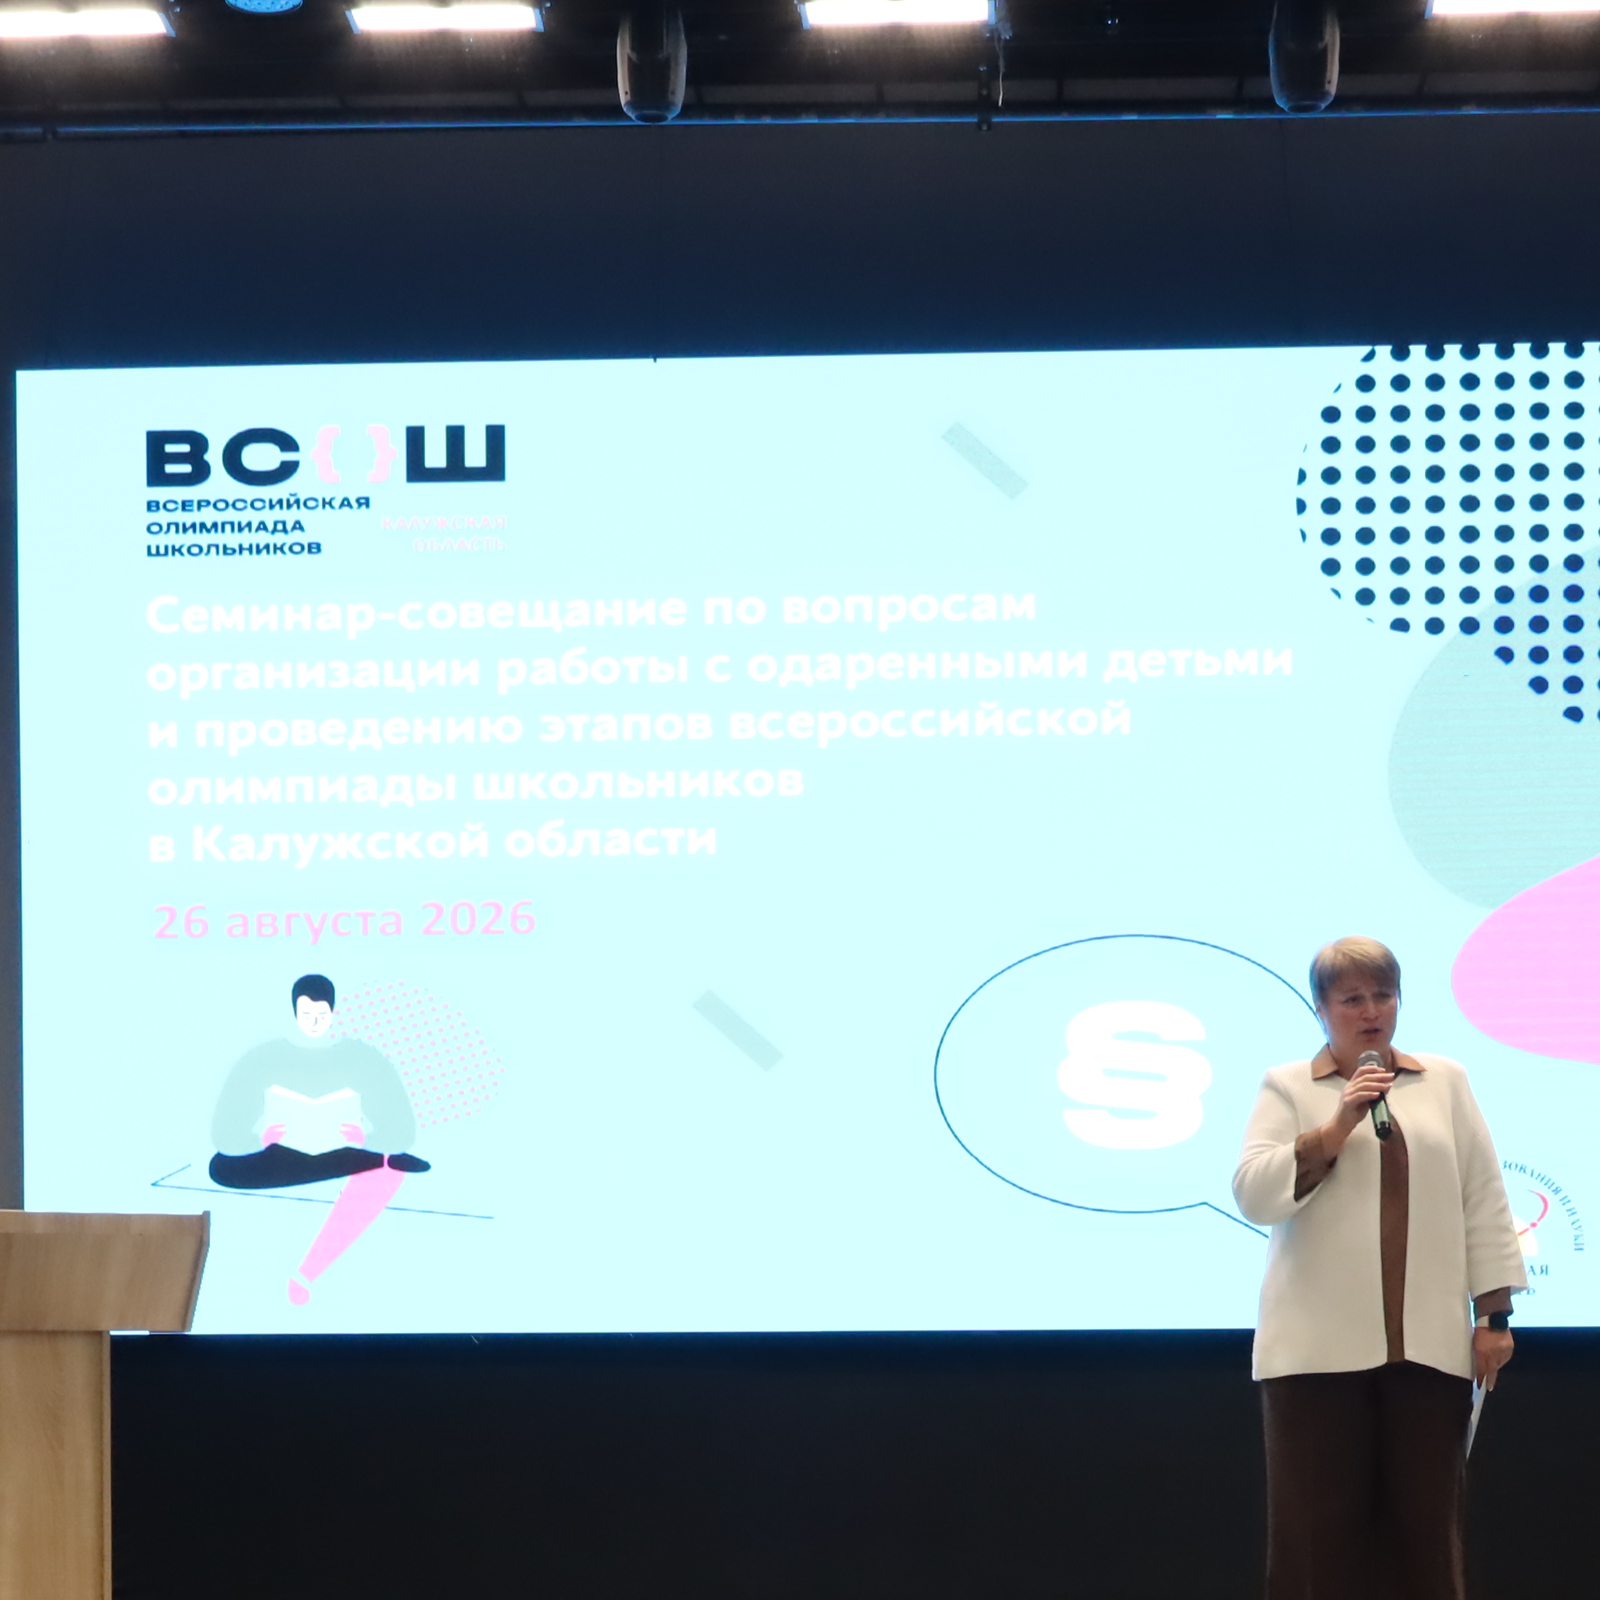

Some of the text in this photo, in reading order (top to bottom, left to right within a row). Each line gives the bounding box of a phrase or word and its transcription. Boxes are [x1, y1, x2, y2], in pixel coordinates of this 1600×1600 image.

[146, 493, 370, 513] ВСЕРОССИЙСКАЯ
[146, 519, 305, 536] ОЛИМПИАДА
[381, 514, 507, 531] КАЛУЖСКАЯ
[147, 542, 322, 557] ШКОЛЬНИКОВ
[413, 536, 507, 552] ОБЛАСТЬ
[146, 593, 1035, 640] Семинар-совещание по вопросам
[147, 646, 1292, 697] организации работы с одаренными детьми
[149, 700, 1130, 755] и проведению этапов всероссийской
[148, 769, 804, 807] олимпиады школьников
[150, 819, 716, 869] в Калужской области
[155, 901, 535, 945] 26 августа 2026
